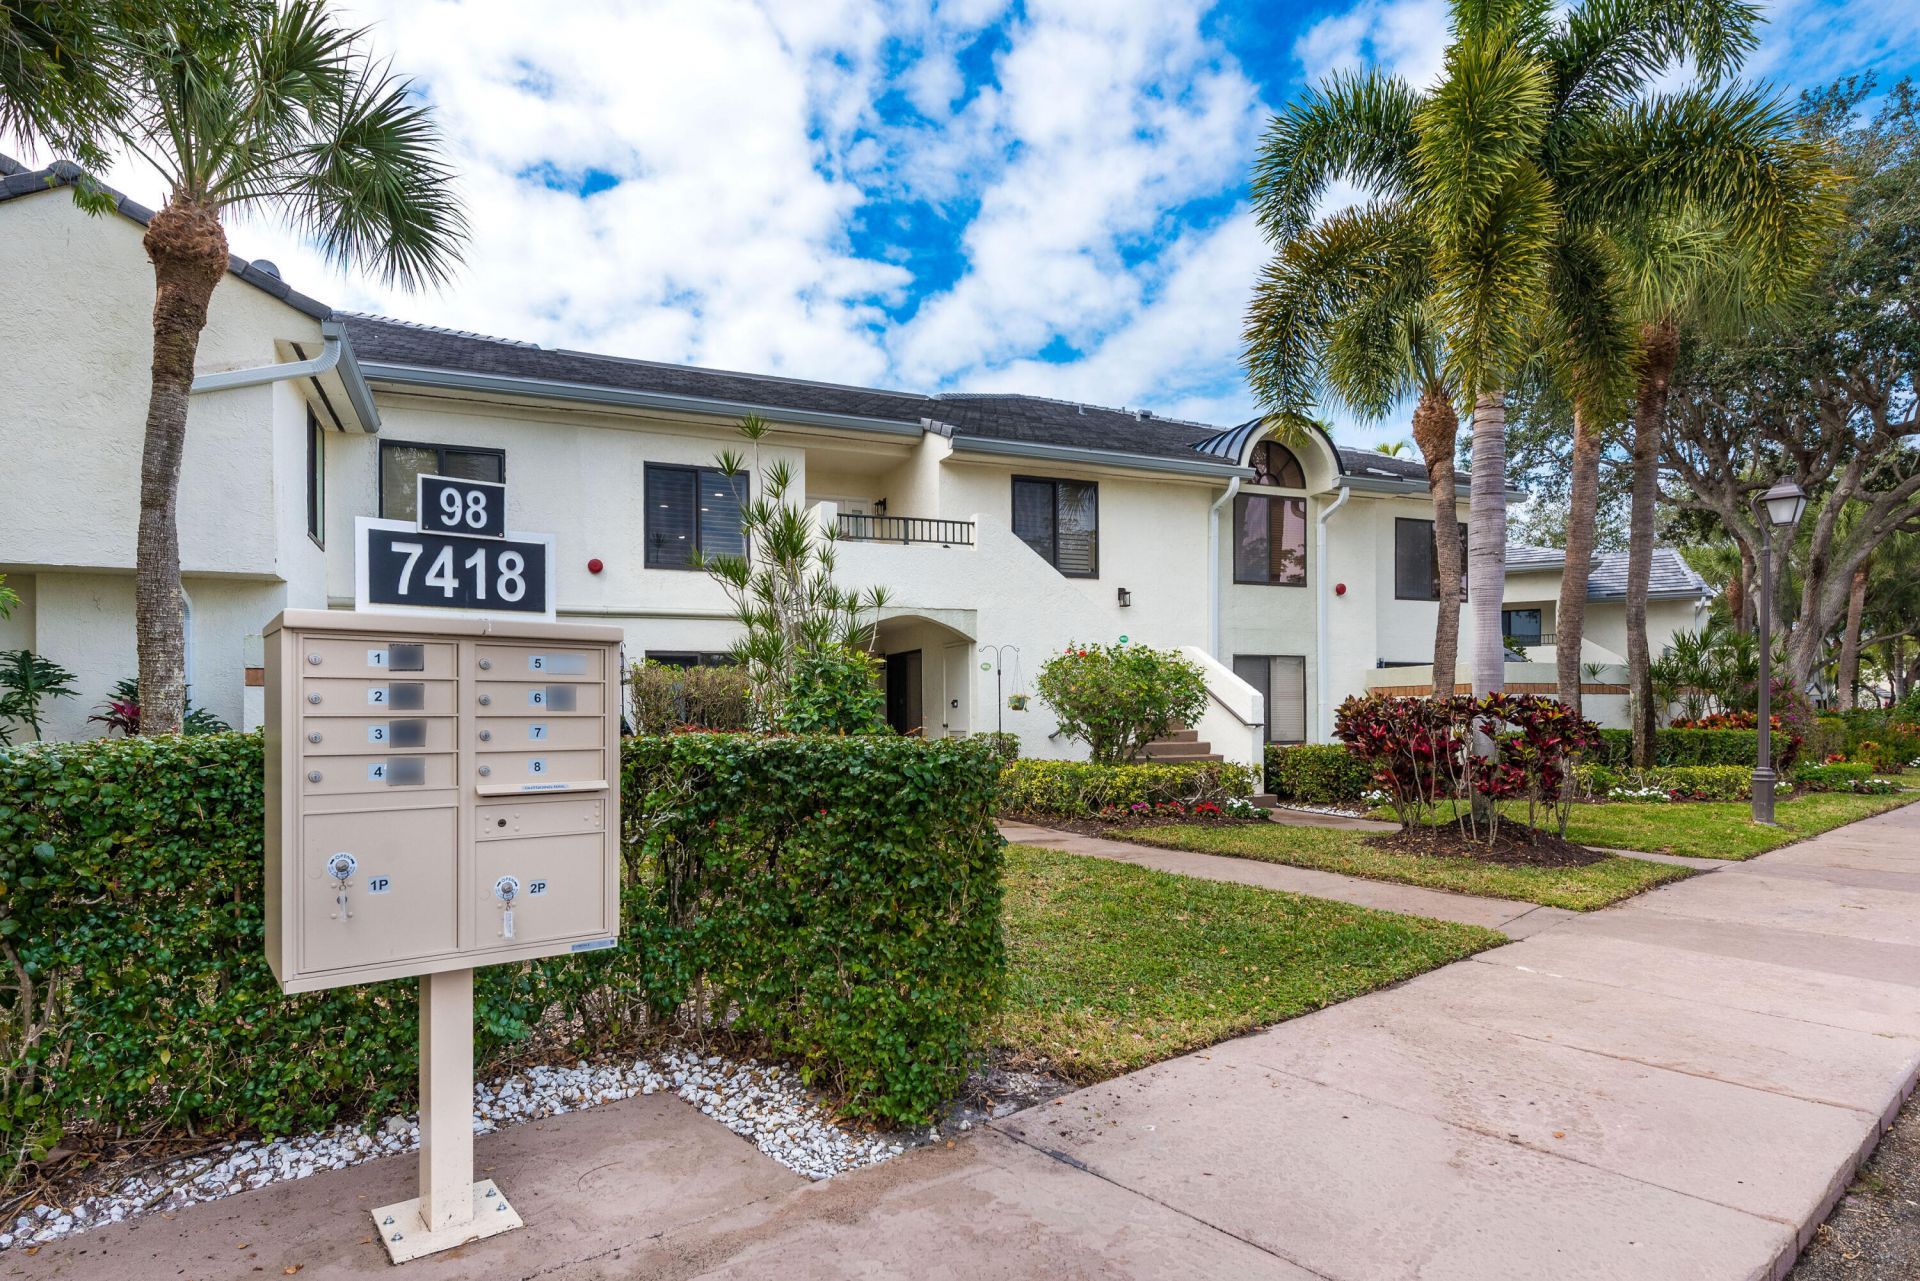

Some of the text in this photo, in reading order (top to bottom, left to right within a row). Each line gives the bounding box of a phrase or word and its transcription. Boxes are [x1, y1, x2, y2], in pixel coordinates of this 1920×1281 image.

[440, 487, 488, 529] 98
[391, 541, 526, 602] 7418
[374, 653, 381, 664] 1
[534, 658, 542, 669] 5
[374, 691, 383, 702] 2
[534, 693, 542, 703] 6
[374, 728, 383, 740] 3
[534, 728, 542, 738] 7
[373, 766, 383, 778] 4
[534, 761, 541, 772] 8
[370, 879, 389, 891] 1P
[530, 882, 546, 894] 2P
